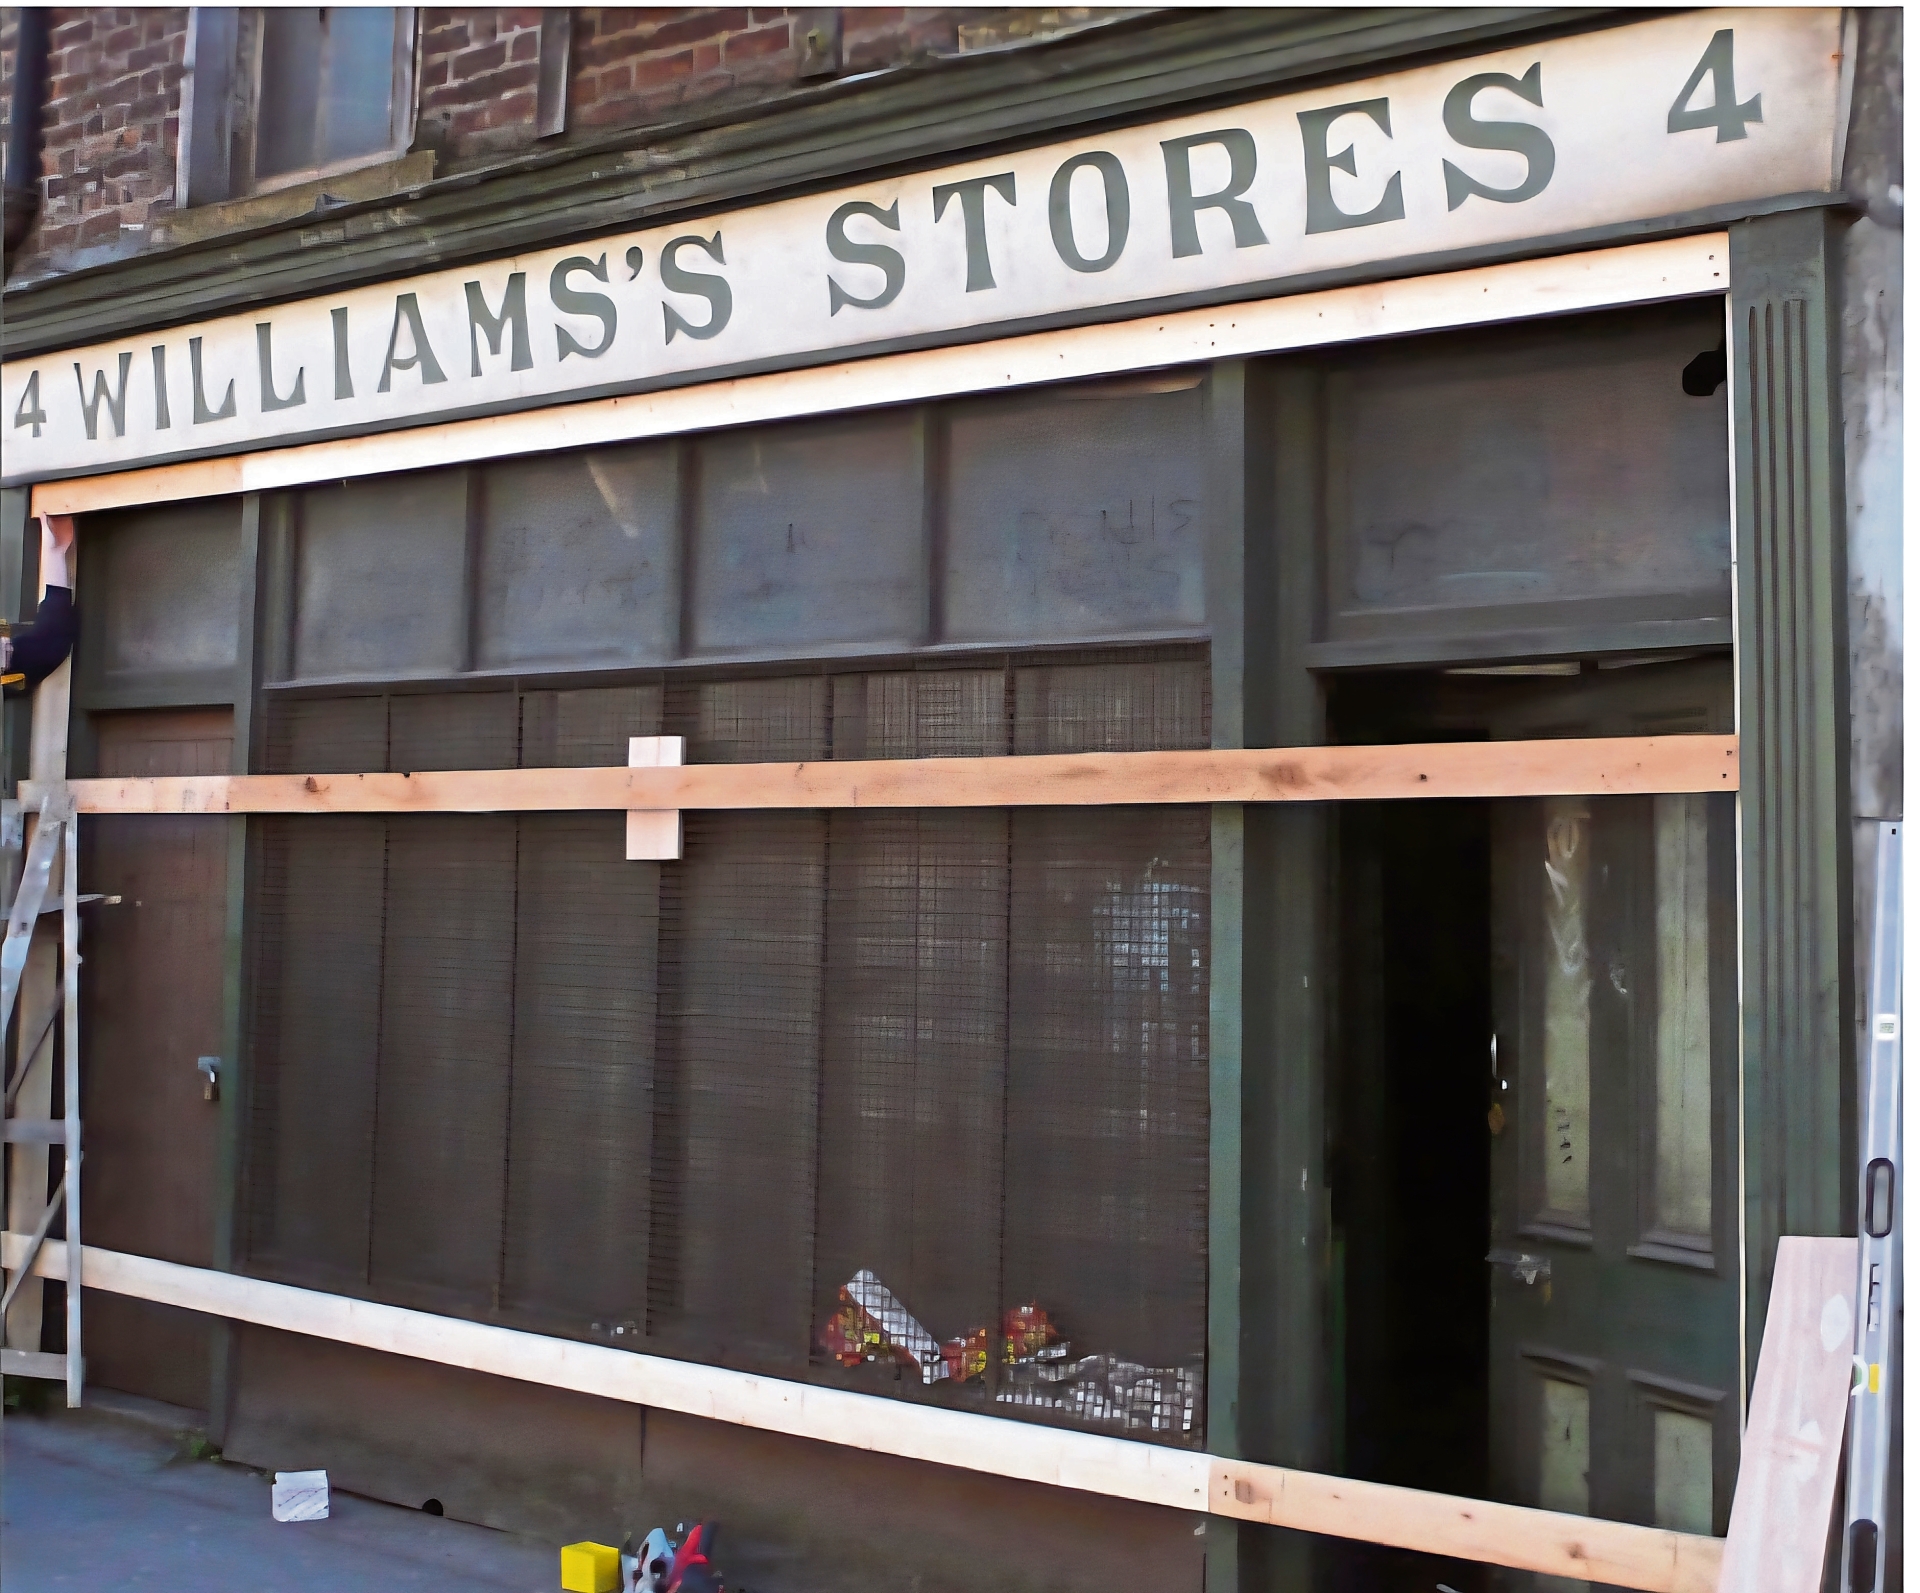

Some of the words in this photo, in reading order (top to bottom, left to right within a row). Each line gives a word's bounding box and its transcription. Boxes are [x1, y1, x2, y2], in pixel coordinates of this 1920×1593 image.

[13, 370, 47, 438] 4
[74, 230, 734, 441] WILLIAMS'S
[826, 61, 1556, 317] STORES
[1667, 29, 1764, 143] 4
